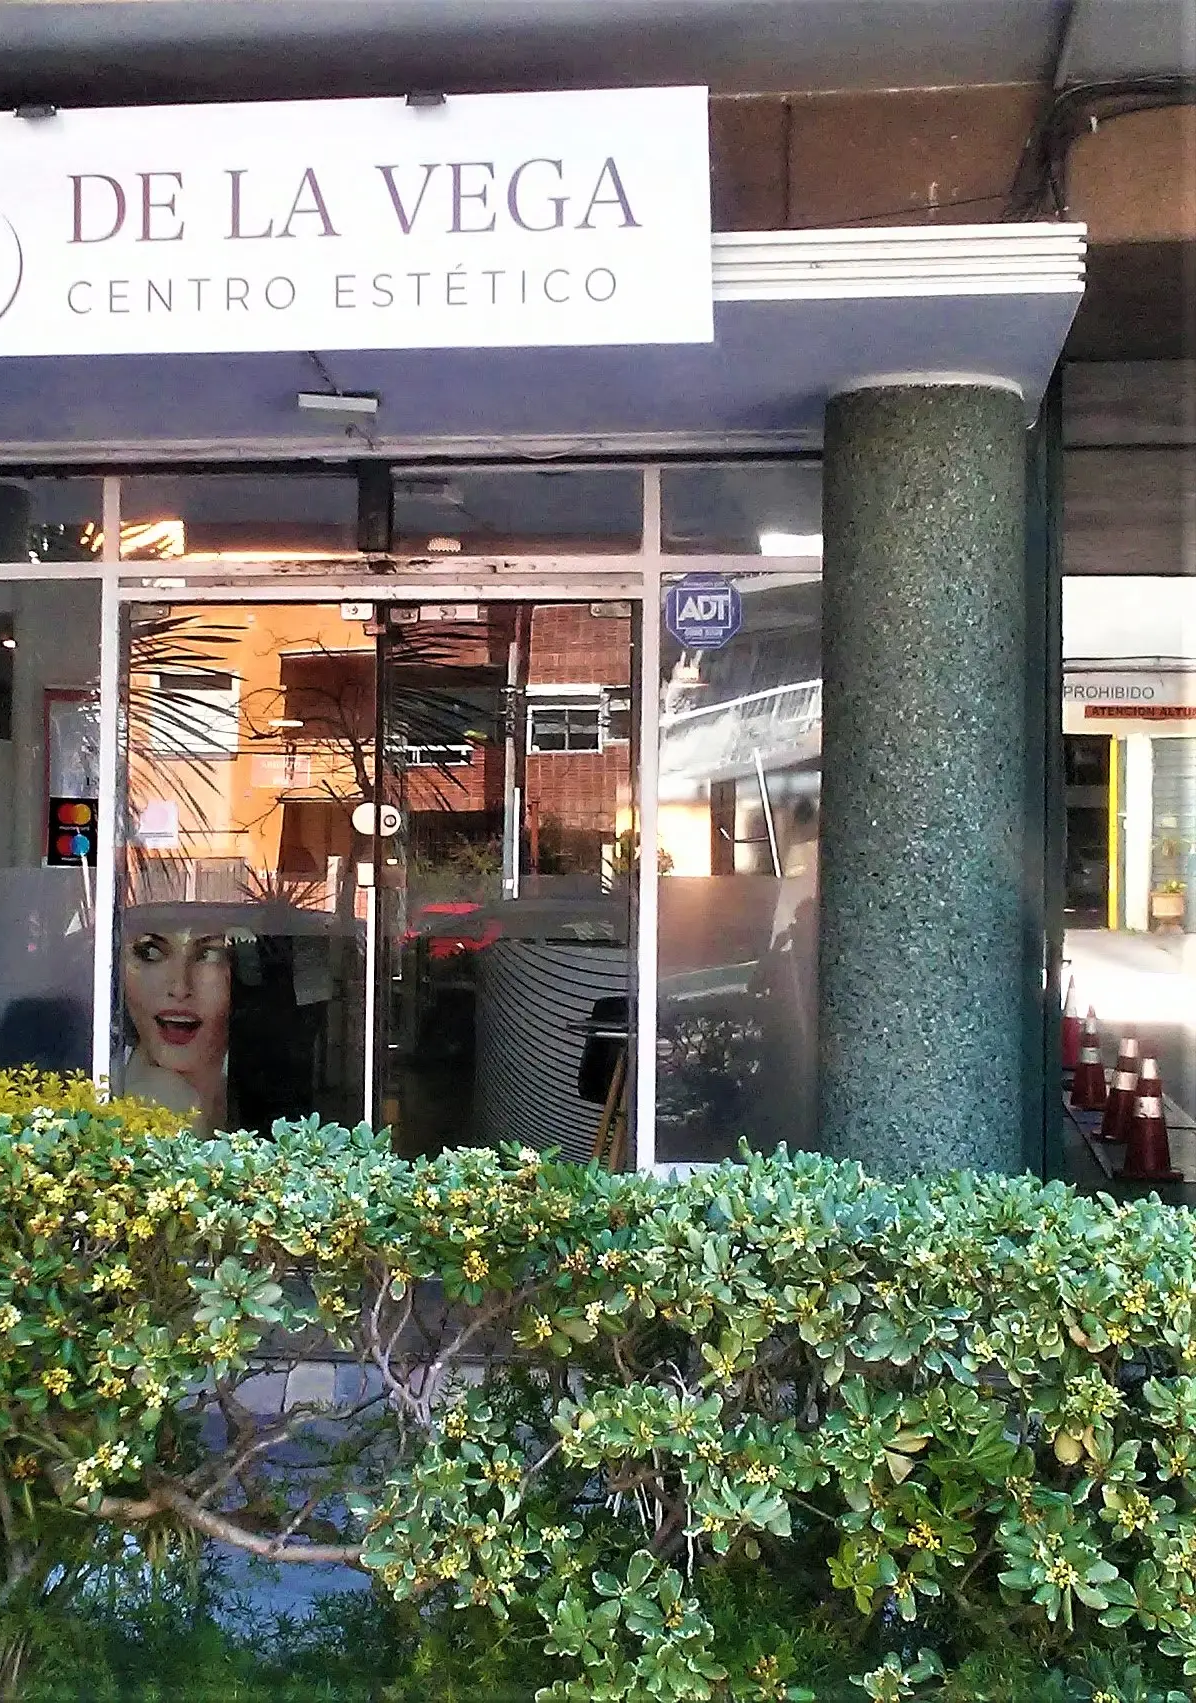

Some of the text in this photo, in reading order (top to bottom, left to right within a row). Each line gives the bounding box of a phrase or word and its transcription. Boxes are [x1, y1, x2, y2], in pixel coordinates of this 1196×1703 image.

[66, 156, 643, 244] DE LA VEGA
[67, 262, 617, 315] CENTRO ESTÉTICO
[678, 595, 730, 621] ADT
[1063, 684, 1155, 700] PROHIBIDO
[1091, 706, 1155, 717] ATENCION
